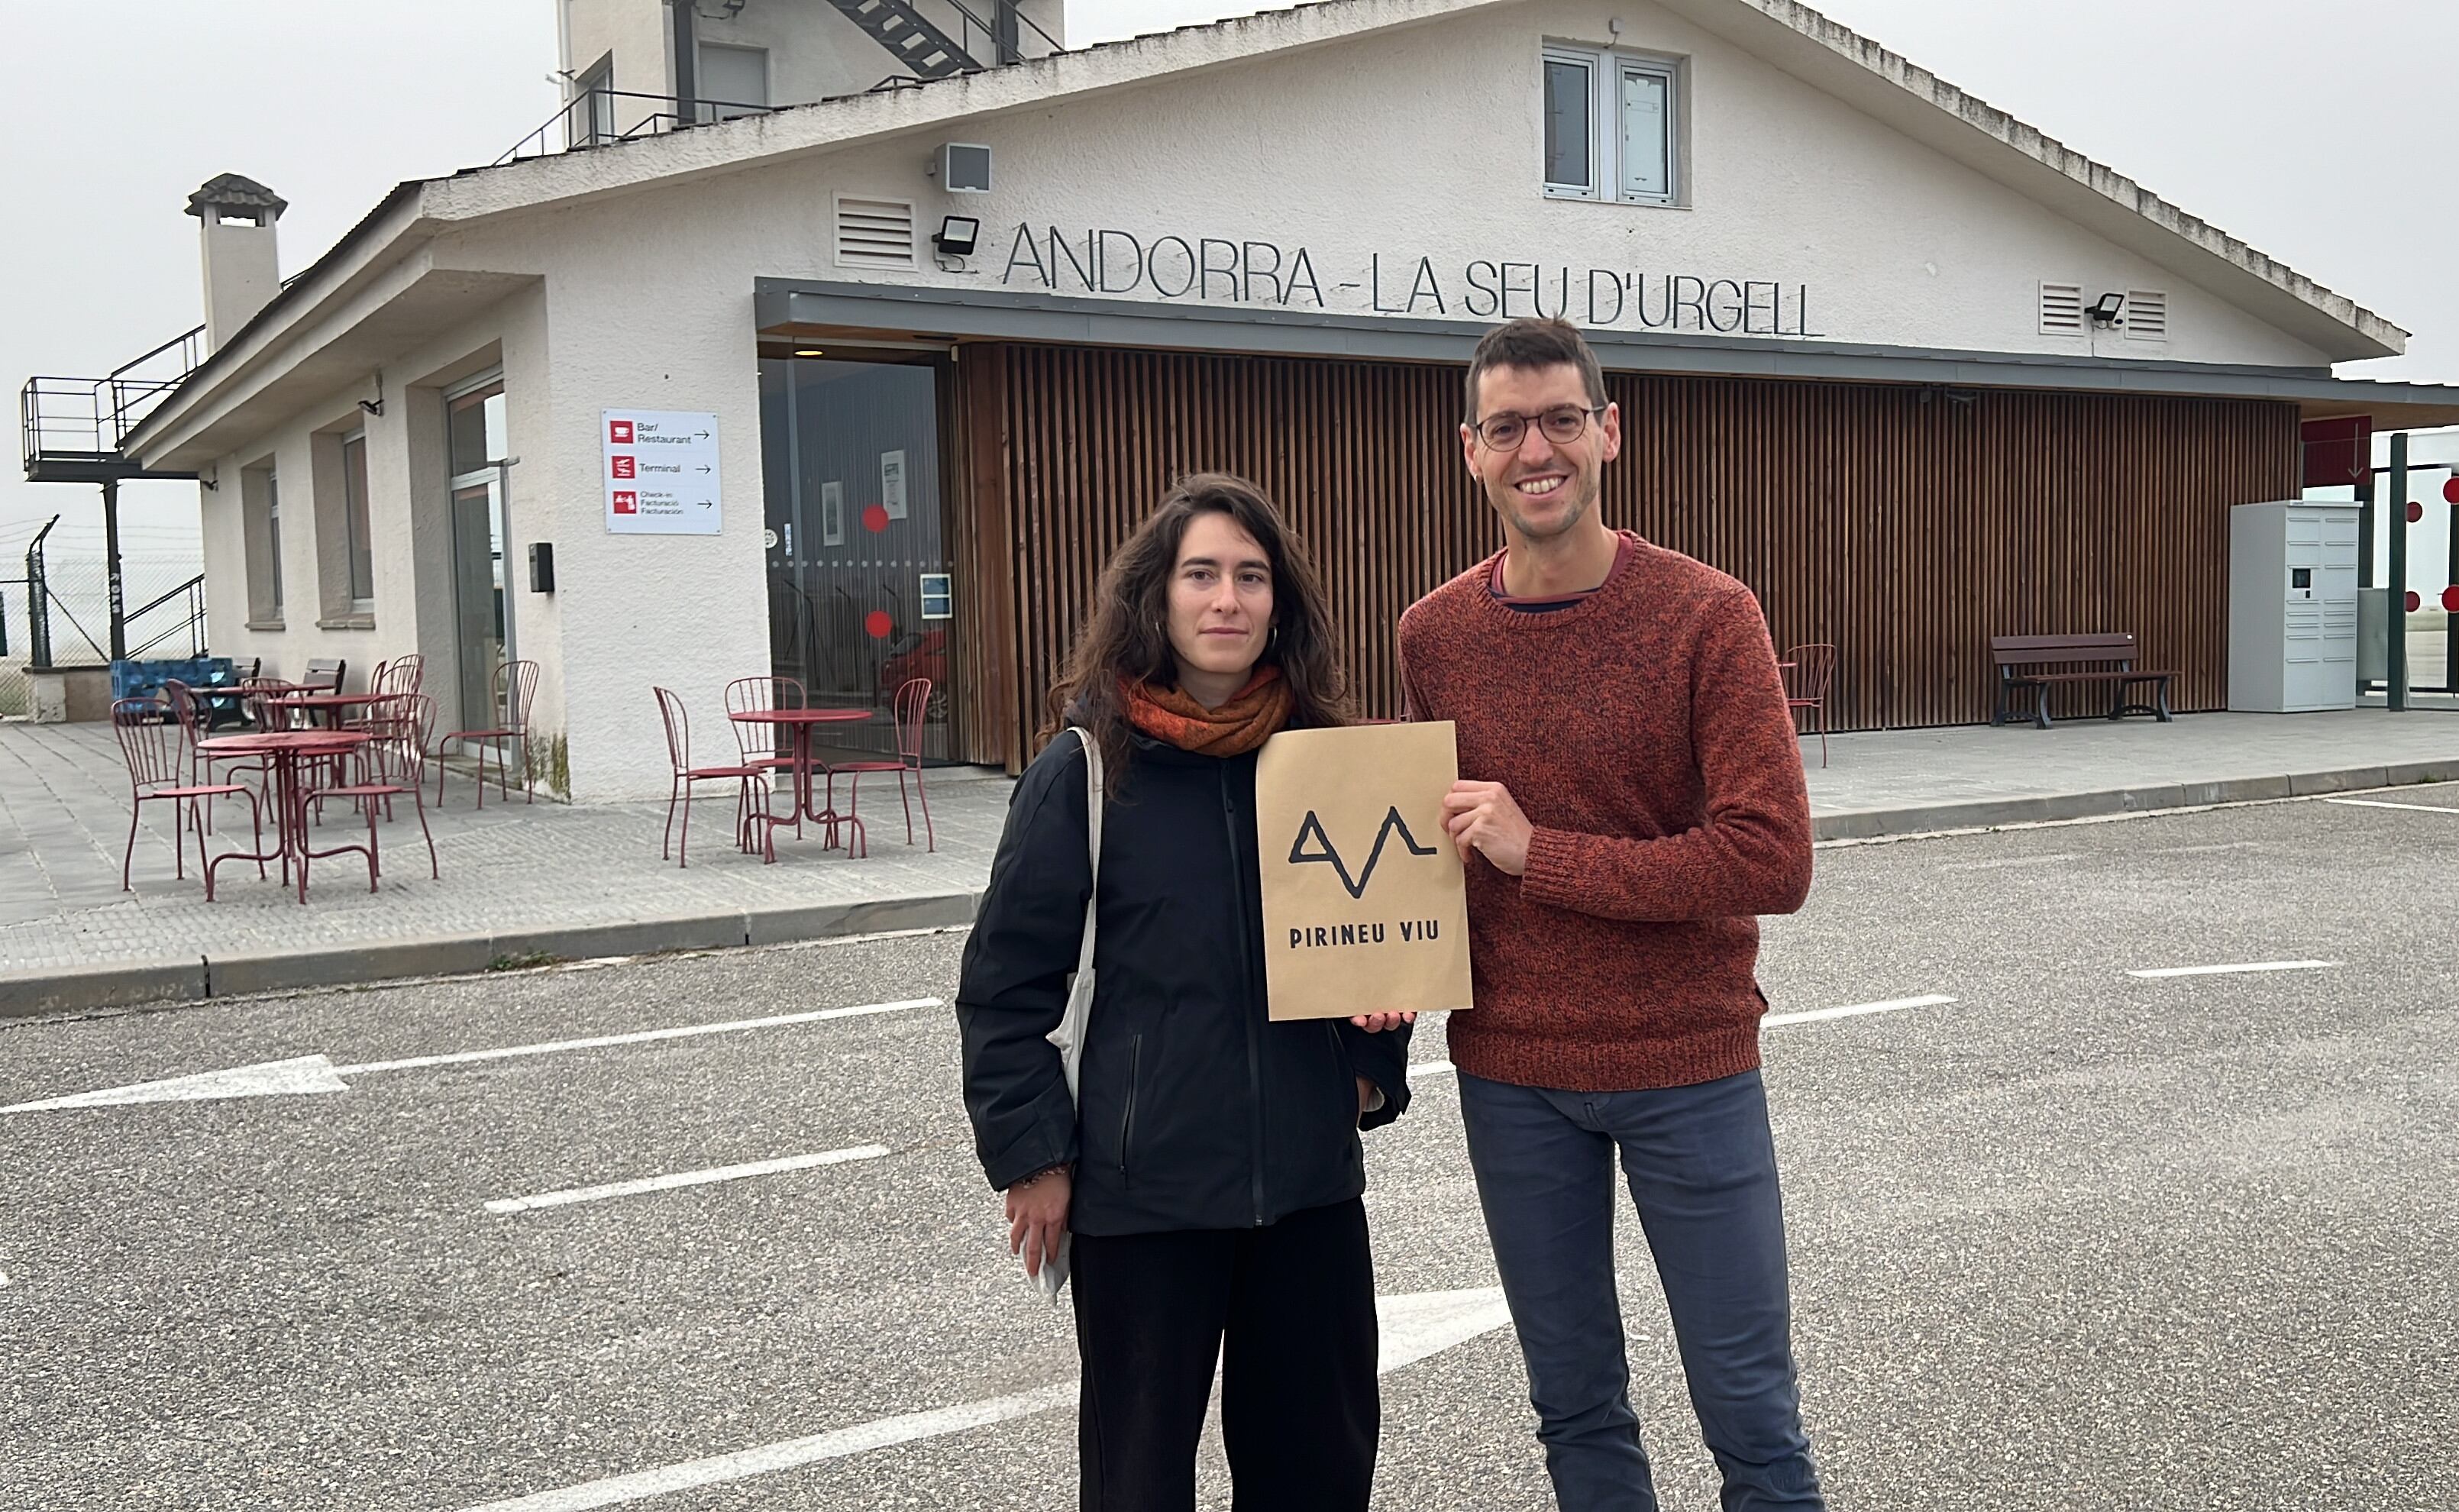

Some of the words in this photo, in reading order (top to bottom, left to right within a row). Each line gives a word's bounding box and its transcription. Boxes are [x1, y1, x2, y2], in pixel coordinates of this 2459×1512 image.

[1003, 221, 1324, 308] ANDORRA
[1372, 253, 1446, 315] LA
[1464, 260, 1568, 320] SEU
[1588, 269, 1825, 338] D'URGELL
[637, 422, 658, 431] Bar/
[638, 434, 691, 444] Restaurant
[639, 463, 680, 473] Terminal
[1289, 922, 1385, 949] PIRINEU
[1399, 919, 1440, 942] VIU
